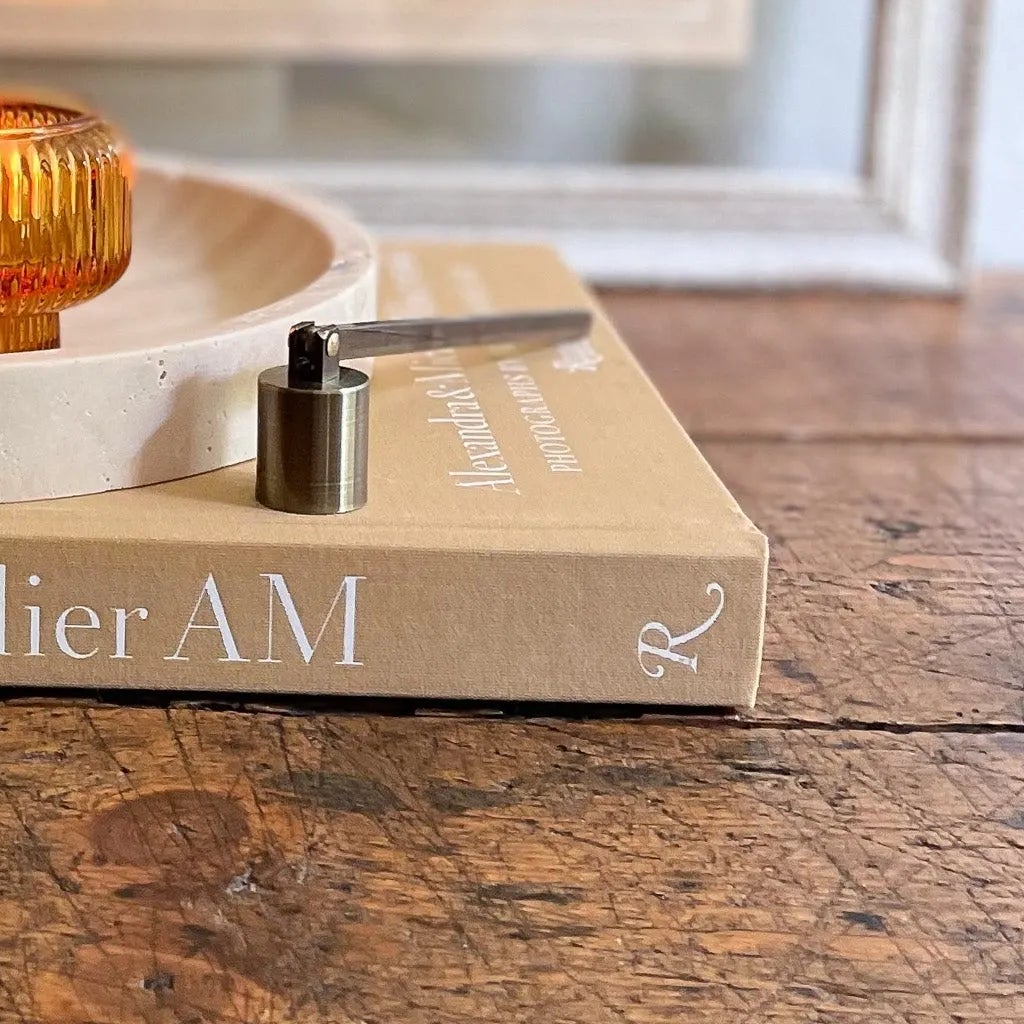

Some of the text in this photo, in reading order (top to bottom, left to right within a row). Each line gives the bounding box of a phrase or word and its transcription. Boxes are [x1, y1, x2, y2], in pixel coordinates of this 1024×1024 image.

[428, 400, 521, 495] Alexandra
[503, 374, 582, 473] PHOTOGRAPHS
[162, 572, 367, 667] AM
